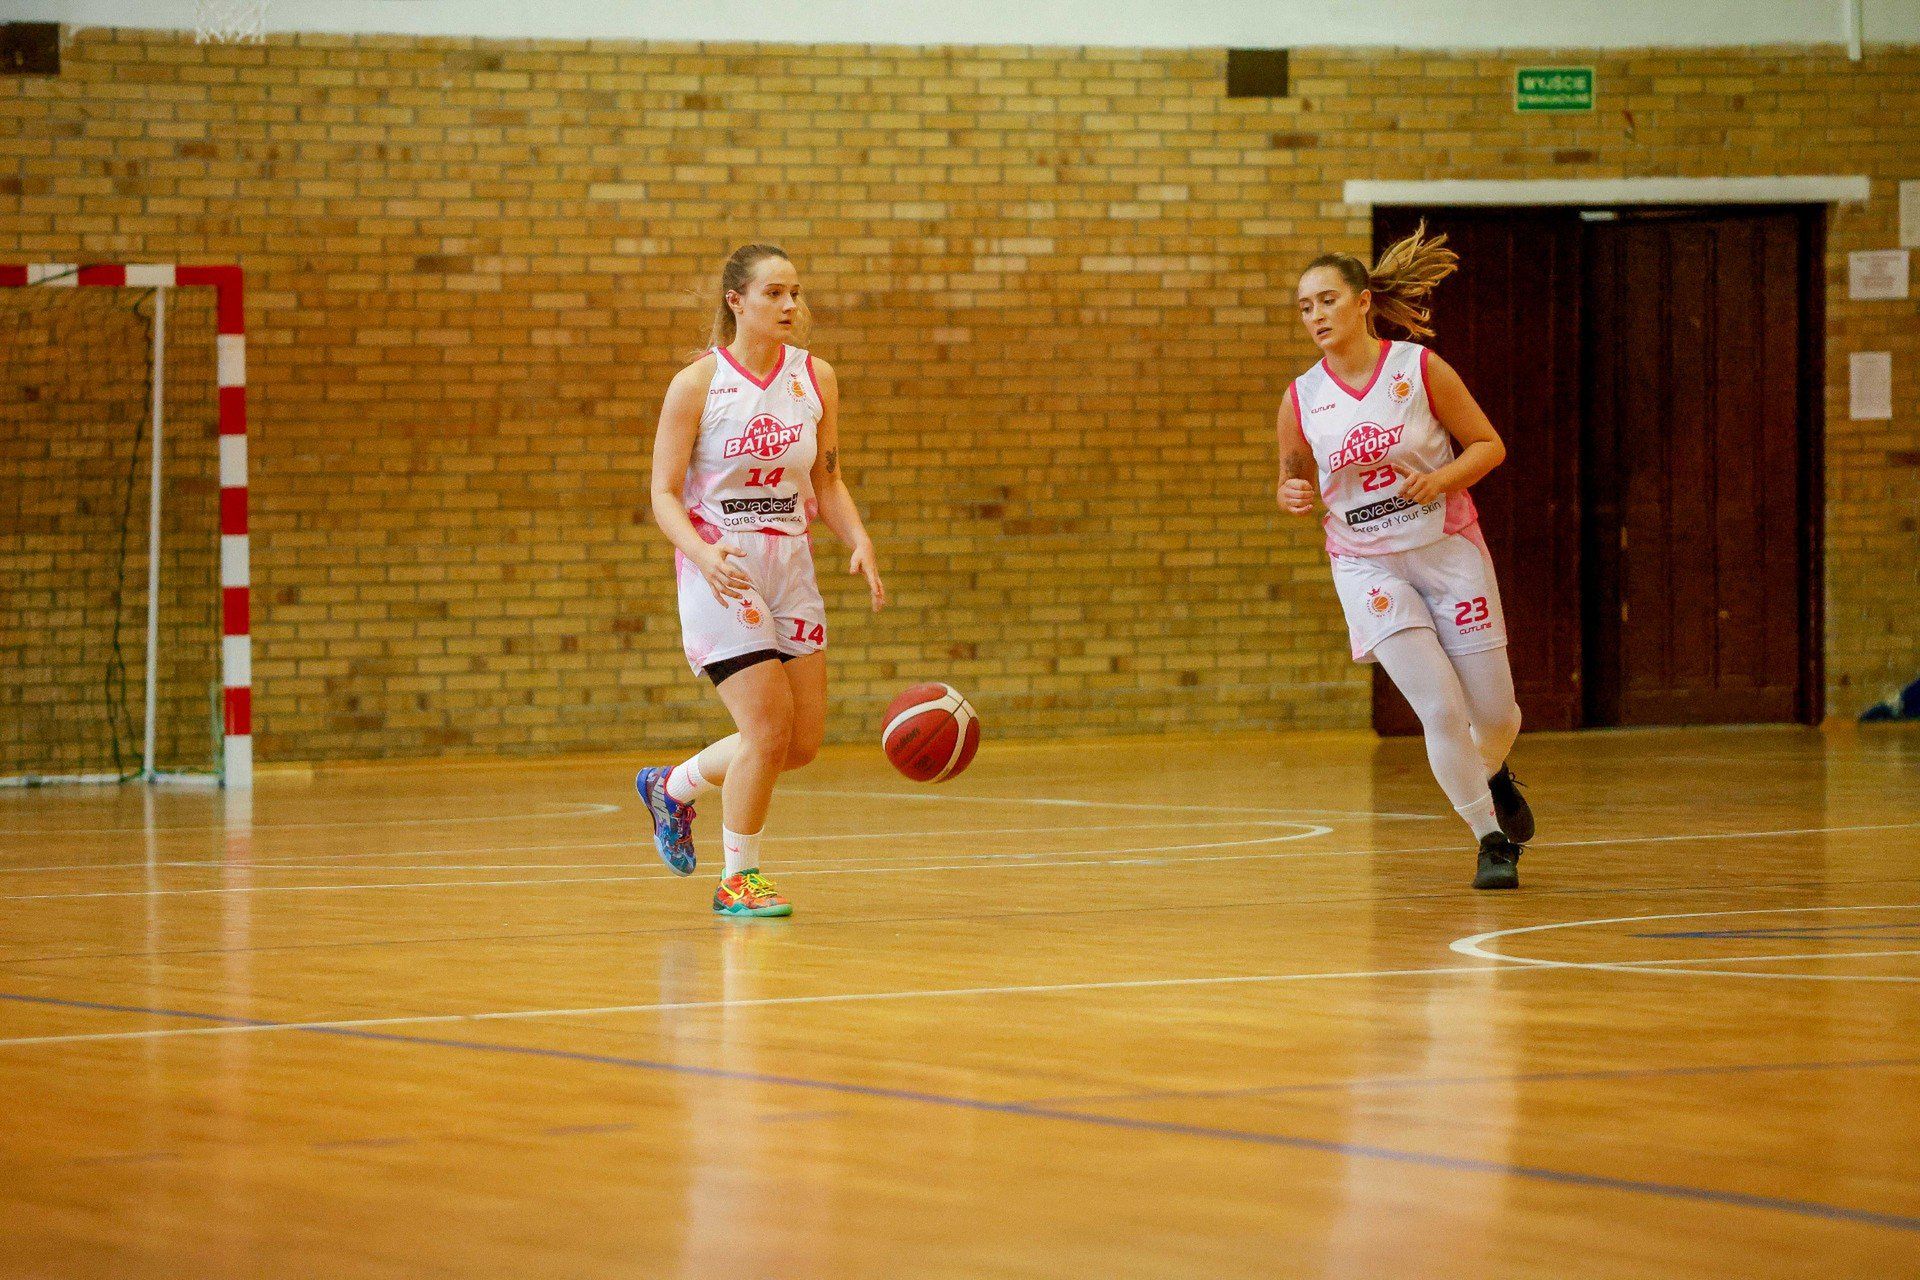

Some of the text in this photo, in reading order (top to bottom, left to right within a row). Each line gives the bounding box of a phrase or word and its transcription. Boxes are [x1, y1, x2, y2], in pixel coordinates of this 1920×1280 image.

[725, 425, 802, 456] BATORY
[753, 424, 777, 436] MKS
[1352, 429, 1375, 445] MKS
[1330, 427, 1403, 471] BATORY
[744, 467, 785, 488] 14
[1359, 464, 1397, 492] 23
[723, 515, 756, 527] Cares
[1348, 496, 1415, 523] novacle
[1381, 517, 1393, 529] of
[1394, 510, 1419, 525] Your
[1421, 501, 1442, 515] Skin
[1455, 596, 1490, 627] 23
[789, 618, 824, 646] 14
